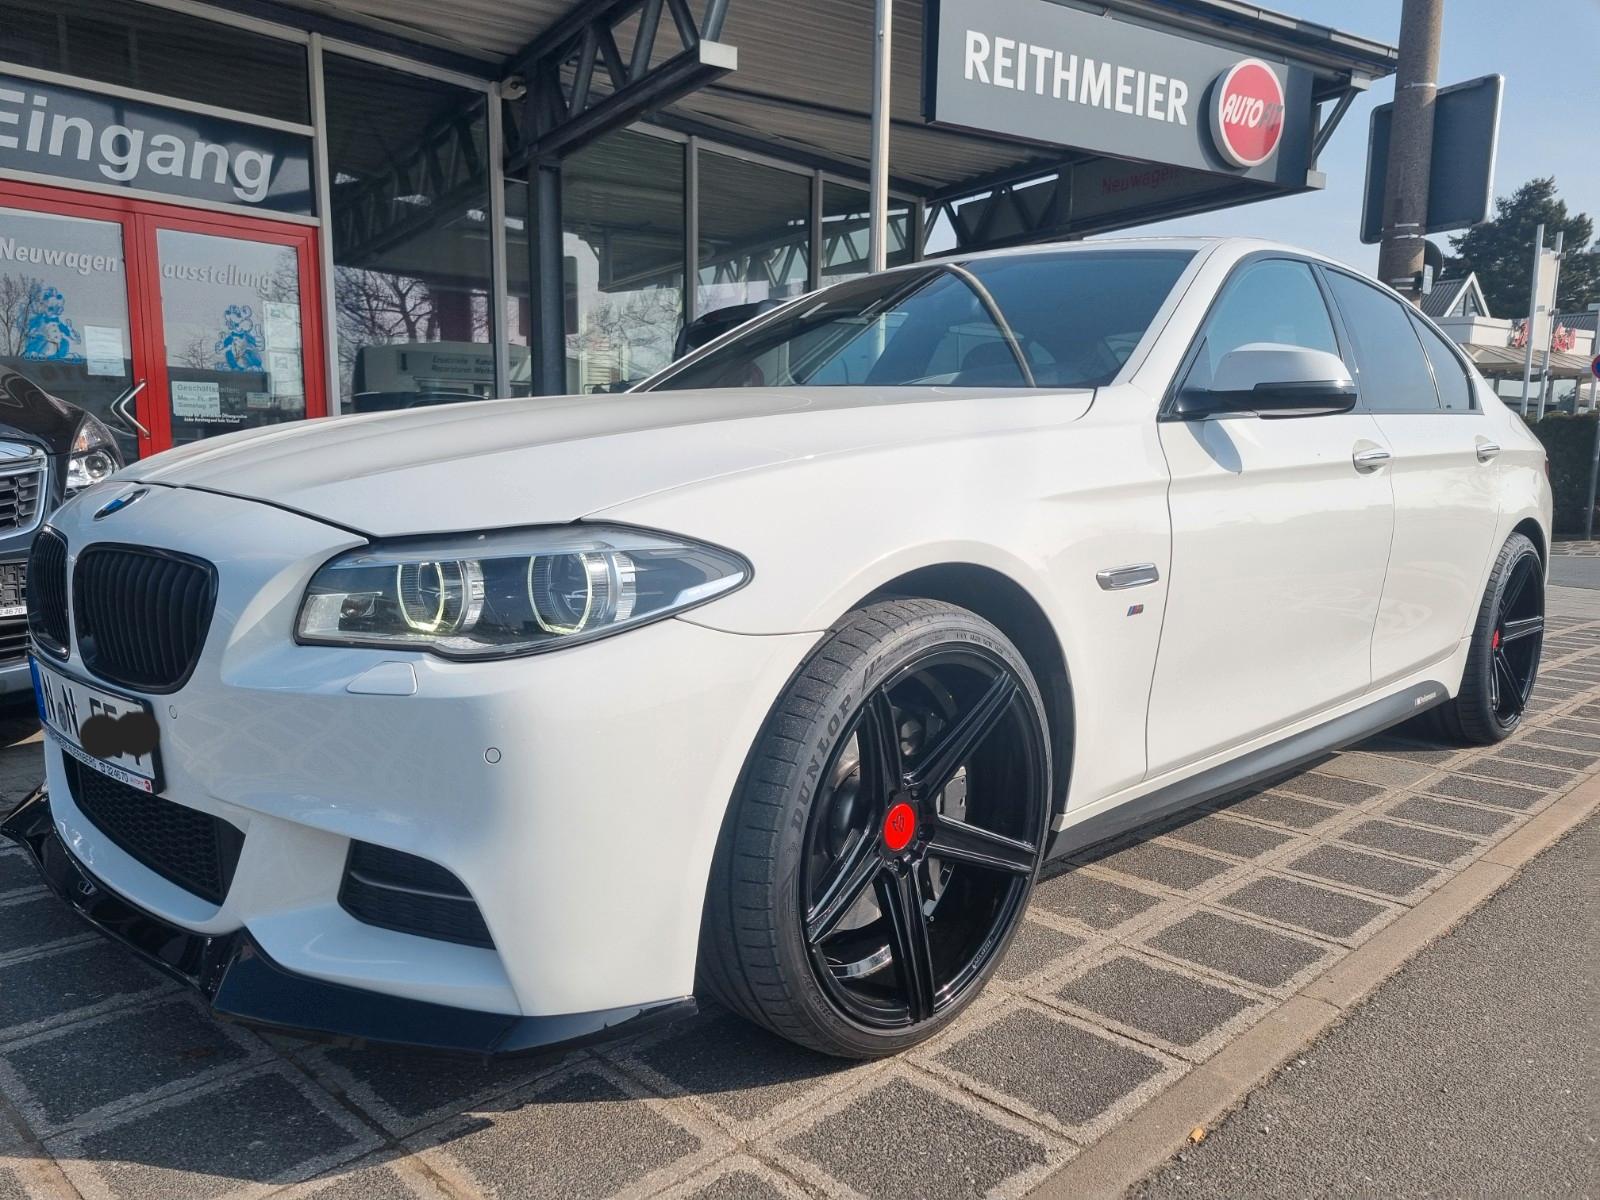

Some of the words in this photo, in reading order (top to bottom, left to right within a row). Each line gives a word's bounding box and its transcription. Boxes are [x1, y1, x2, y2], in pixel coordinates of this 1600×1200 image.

[964, 29, 1189, 126] REITHMEIER
[0, 88, 273, 203] Eingang
[0, 236, 118, 276] Neuwagen
[161, 262, 274, 294] ausstellung
[790, 693, 854, 831] DUNLOP
